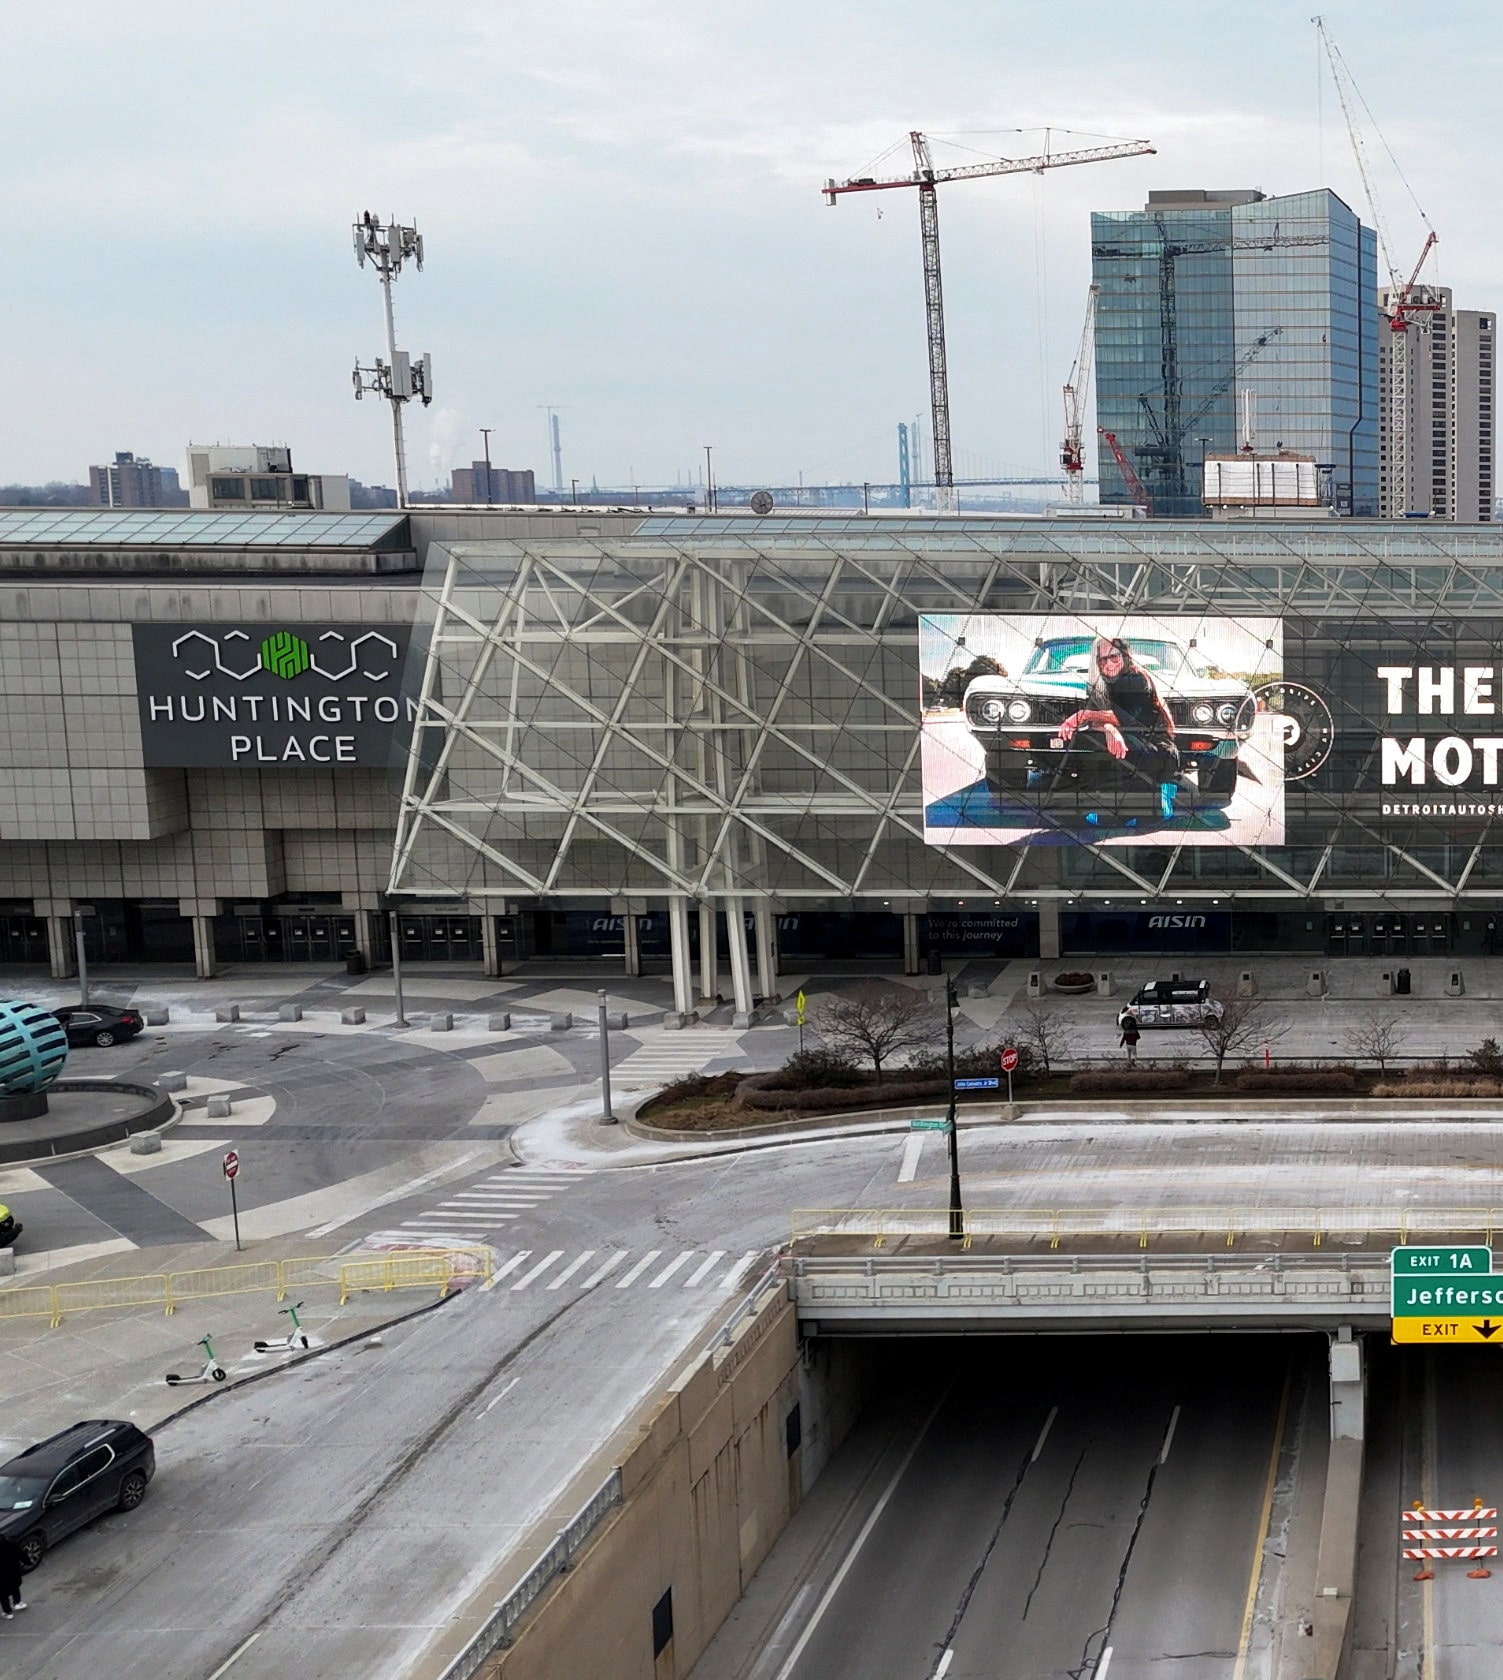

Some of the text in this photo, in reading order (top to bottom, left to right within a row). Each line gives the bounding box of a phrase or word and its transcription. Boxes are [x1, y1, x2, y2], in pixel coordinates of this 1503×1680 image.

[231, 735, 357, 762] PLACE
[961, 917, 1019, 928] committed
[1148, 915, 1206, 928] AISIN
[1003, 1054, 1017, 1065] STOP
[1410, 1253, 1473, 1269] EXIT 1A
[1422, 1324, 1459, 1336] EXIT
